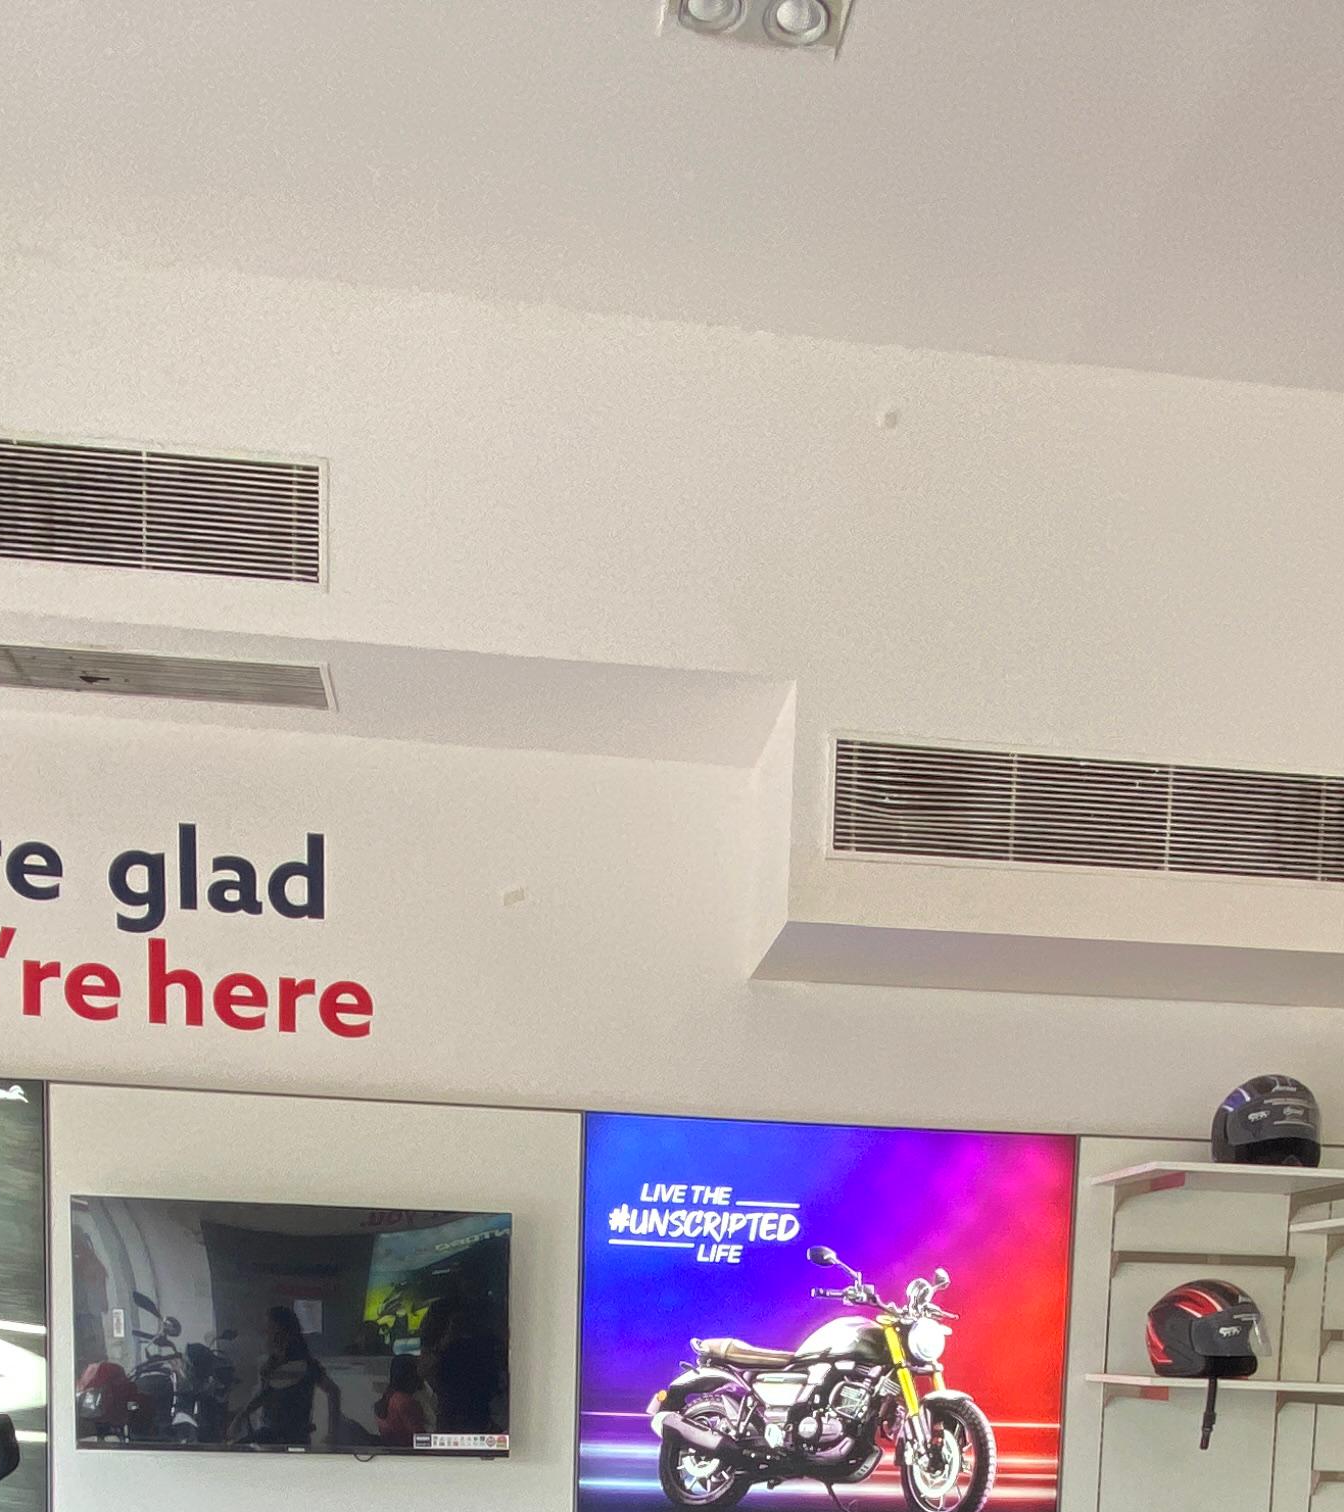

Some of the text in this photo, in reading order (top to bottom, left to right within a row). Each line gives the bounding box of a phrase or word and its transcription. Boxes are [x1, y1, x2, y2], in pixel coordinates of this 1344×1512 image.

[108, 822, 326, 934] glad
[148, 937, 374, 1039] here
[639, 1183, 733, 1206] LIVE THE
[608, 1203, 801, 1243] #UNSCRIPTED
[696, 1243, 744, 1264] LIFE
